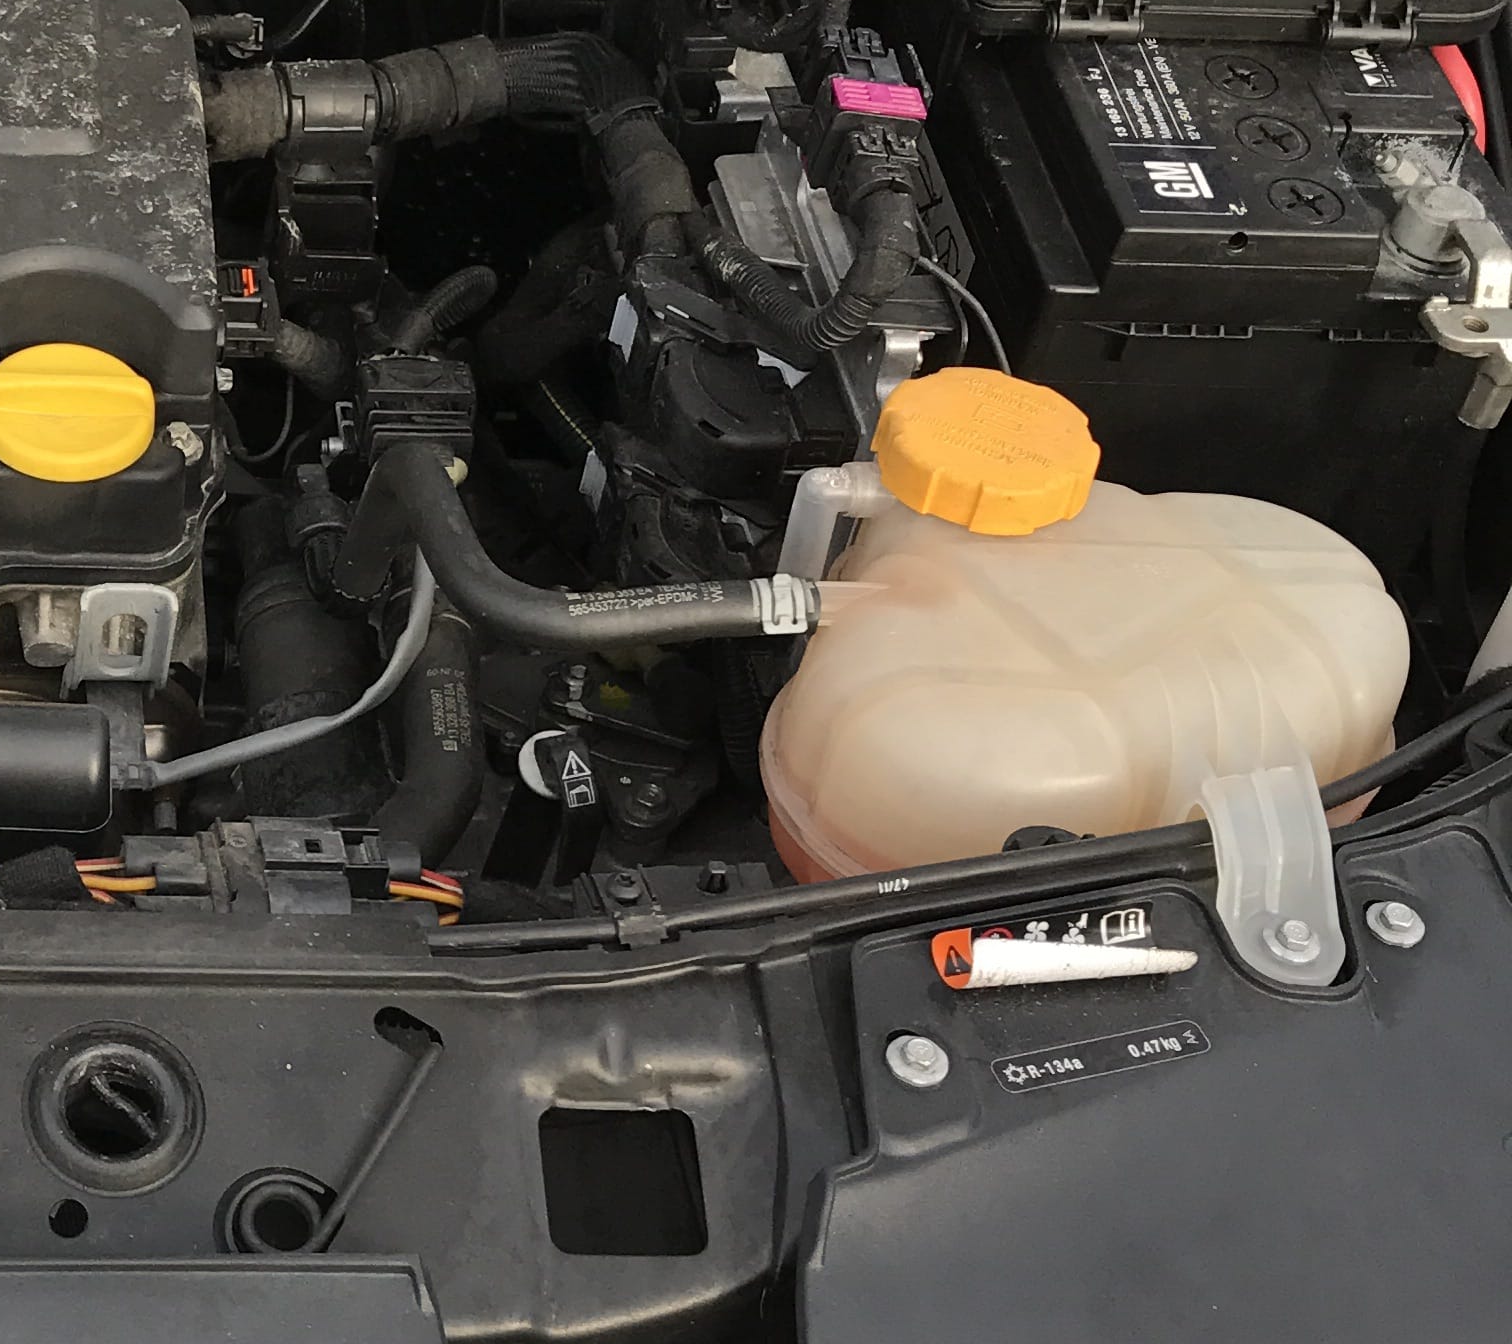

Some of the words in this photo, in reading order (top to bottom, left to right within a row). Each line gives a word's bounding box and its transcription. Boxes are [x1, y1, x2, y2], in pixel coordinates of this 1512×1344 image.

[1134, 69, 1149, 87] Free
[1143, 88, 1173, 139] Maintenance
[1143, 161, 1200, 198] GM
[1026, 1058, 1085, 1079] R-134a
